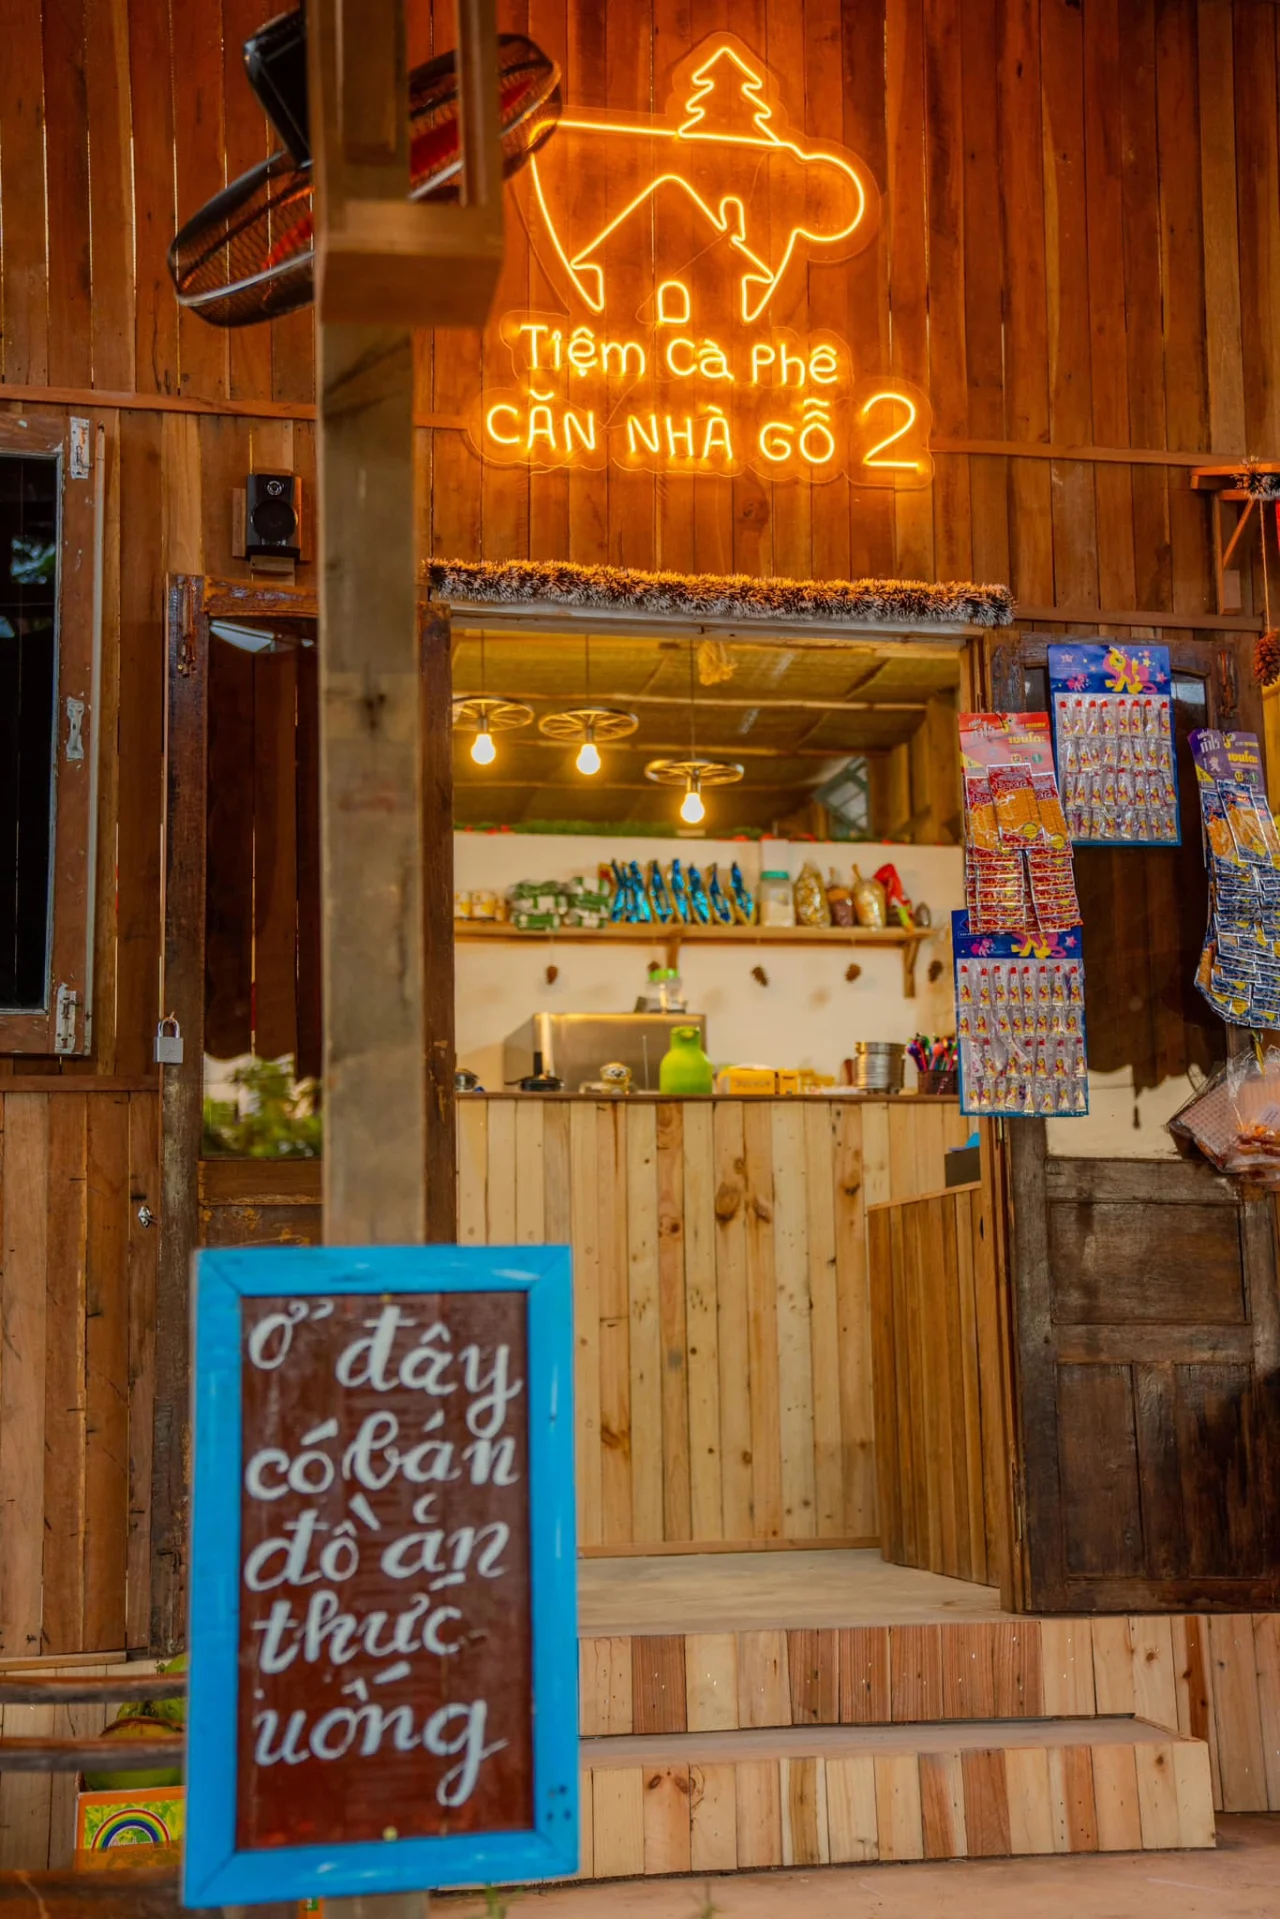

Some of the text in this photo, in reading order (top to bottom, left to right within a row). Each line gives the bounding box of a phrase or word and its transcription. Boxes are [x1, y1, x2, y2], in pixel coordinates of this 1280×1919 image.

[519, 324, 839, 386] Tiệm Cà Phê
[486, 388, 920, 469] CĂN NHÀ GỖ 2
[336, 1304, 524, 1440] đây
[244, 1409, 520, 1501] có bán
[244, 1492, 512, 1593] đồ ăn
[252, 1572, 467, 1675] thức
[252, 1660, 510, 1808] uống
